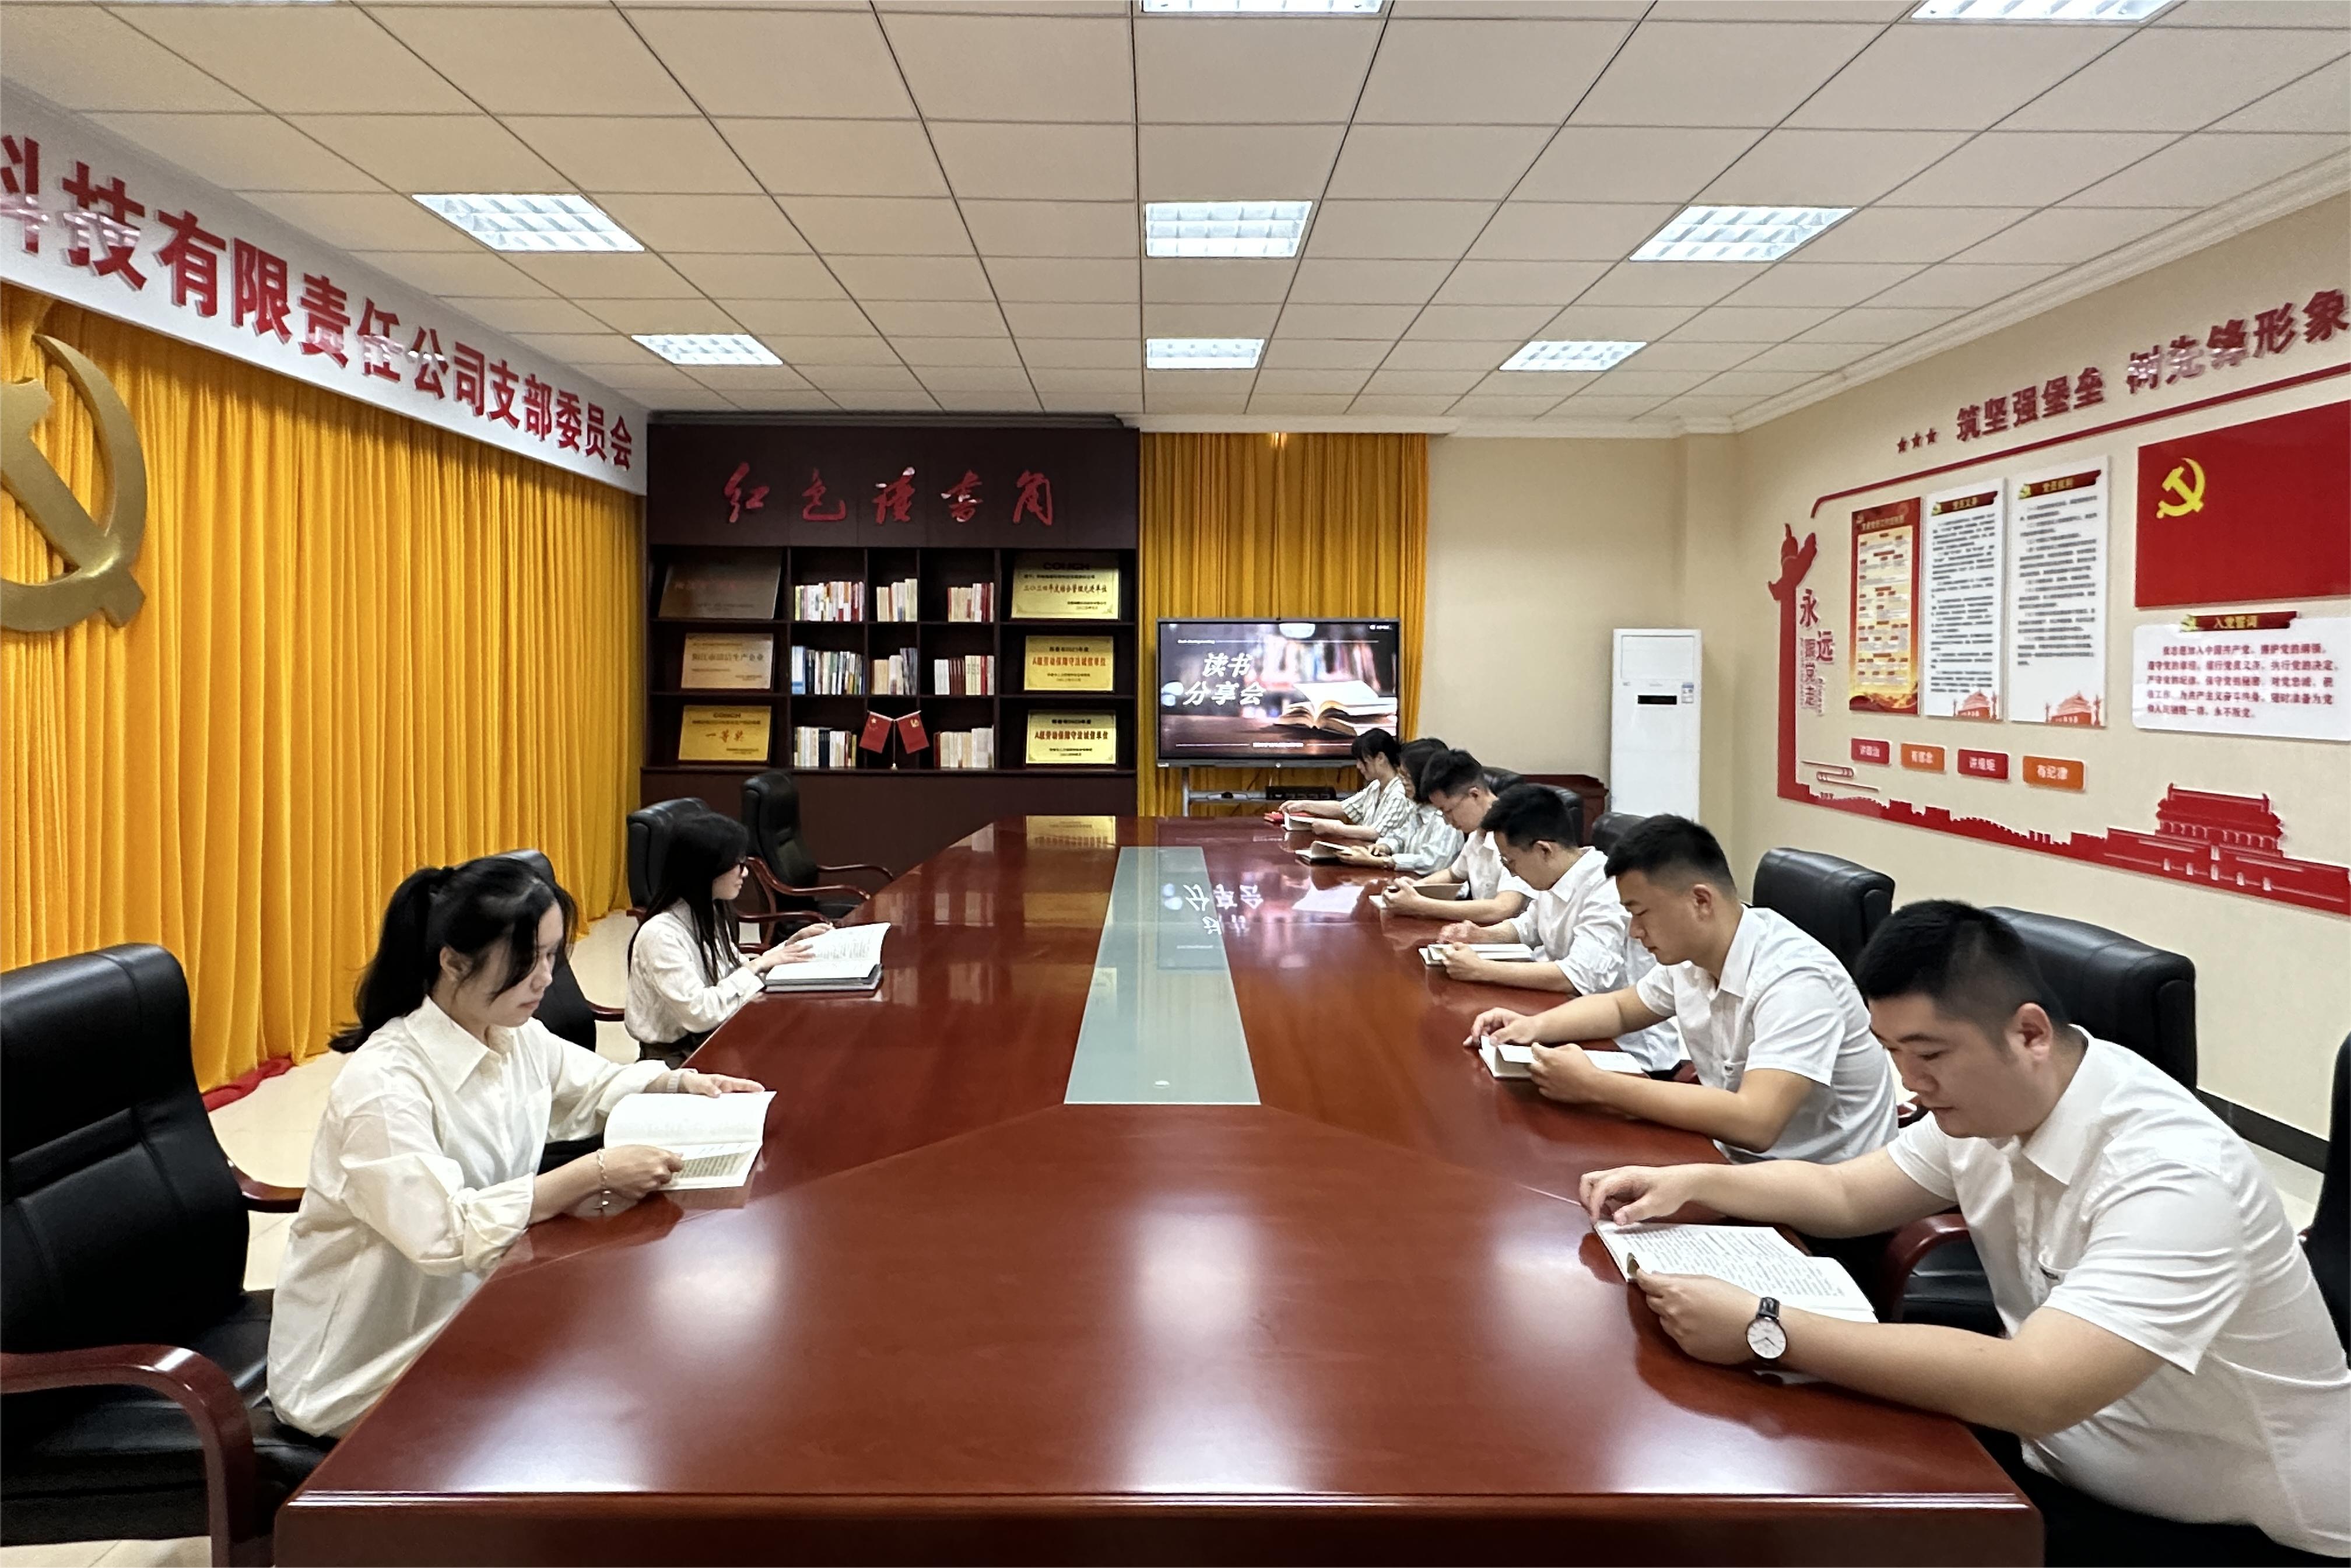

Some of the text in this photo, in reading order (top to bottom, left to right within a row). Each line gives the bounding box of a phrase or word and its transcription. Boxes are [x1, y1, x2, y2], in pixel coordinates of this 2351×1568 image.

[1957, 289, 2350, 441] 筑坚强堡垒 树先锋形象
[1202, 653, 1254, 678] 读书
[1182, 680, 1266, 706] 分享会
